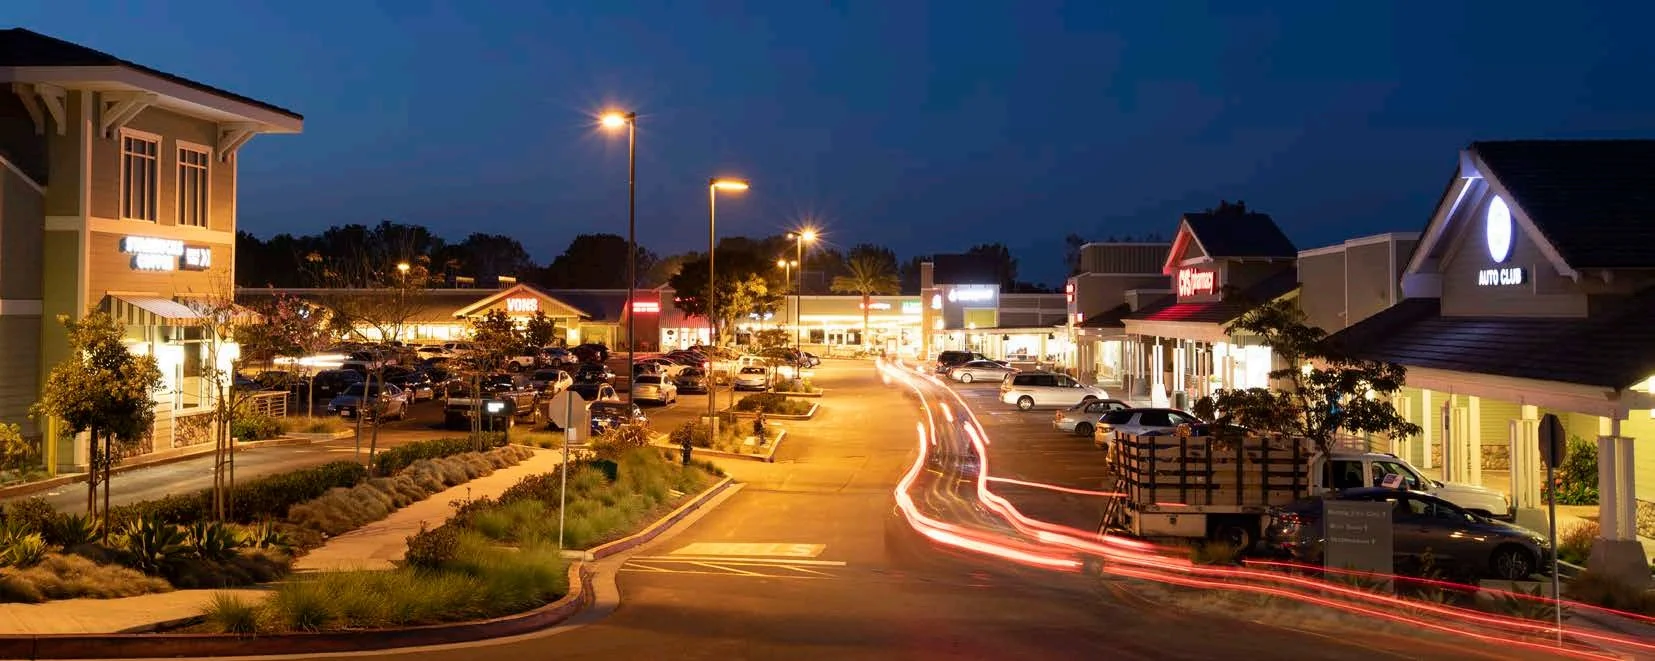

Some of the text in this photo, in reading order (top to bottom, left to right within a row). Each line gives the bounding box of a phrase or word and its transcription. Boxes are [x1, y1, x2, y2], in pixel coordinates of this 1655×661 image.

[1479, 267, 1522, 286] AUTO CLUB
[507, 297, 538, 312] VONS
